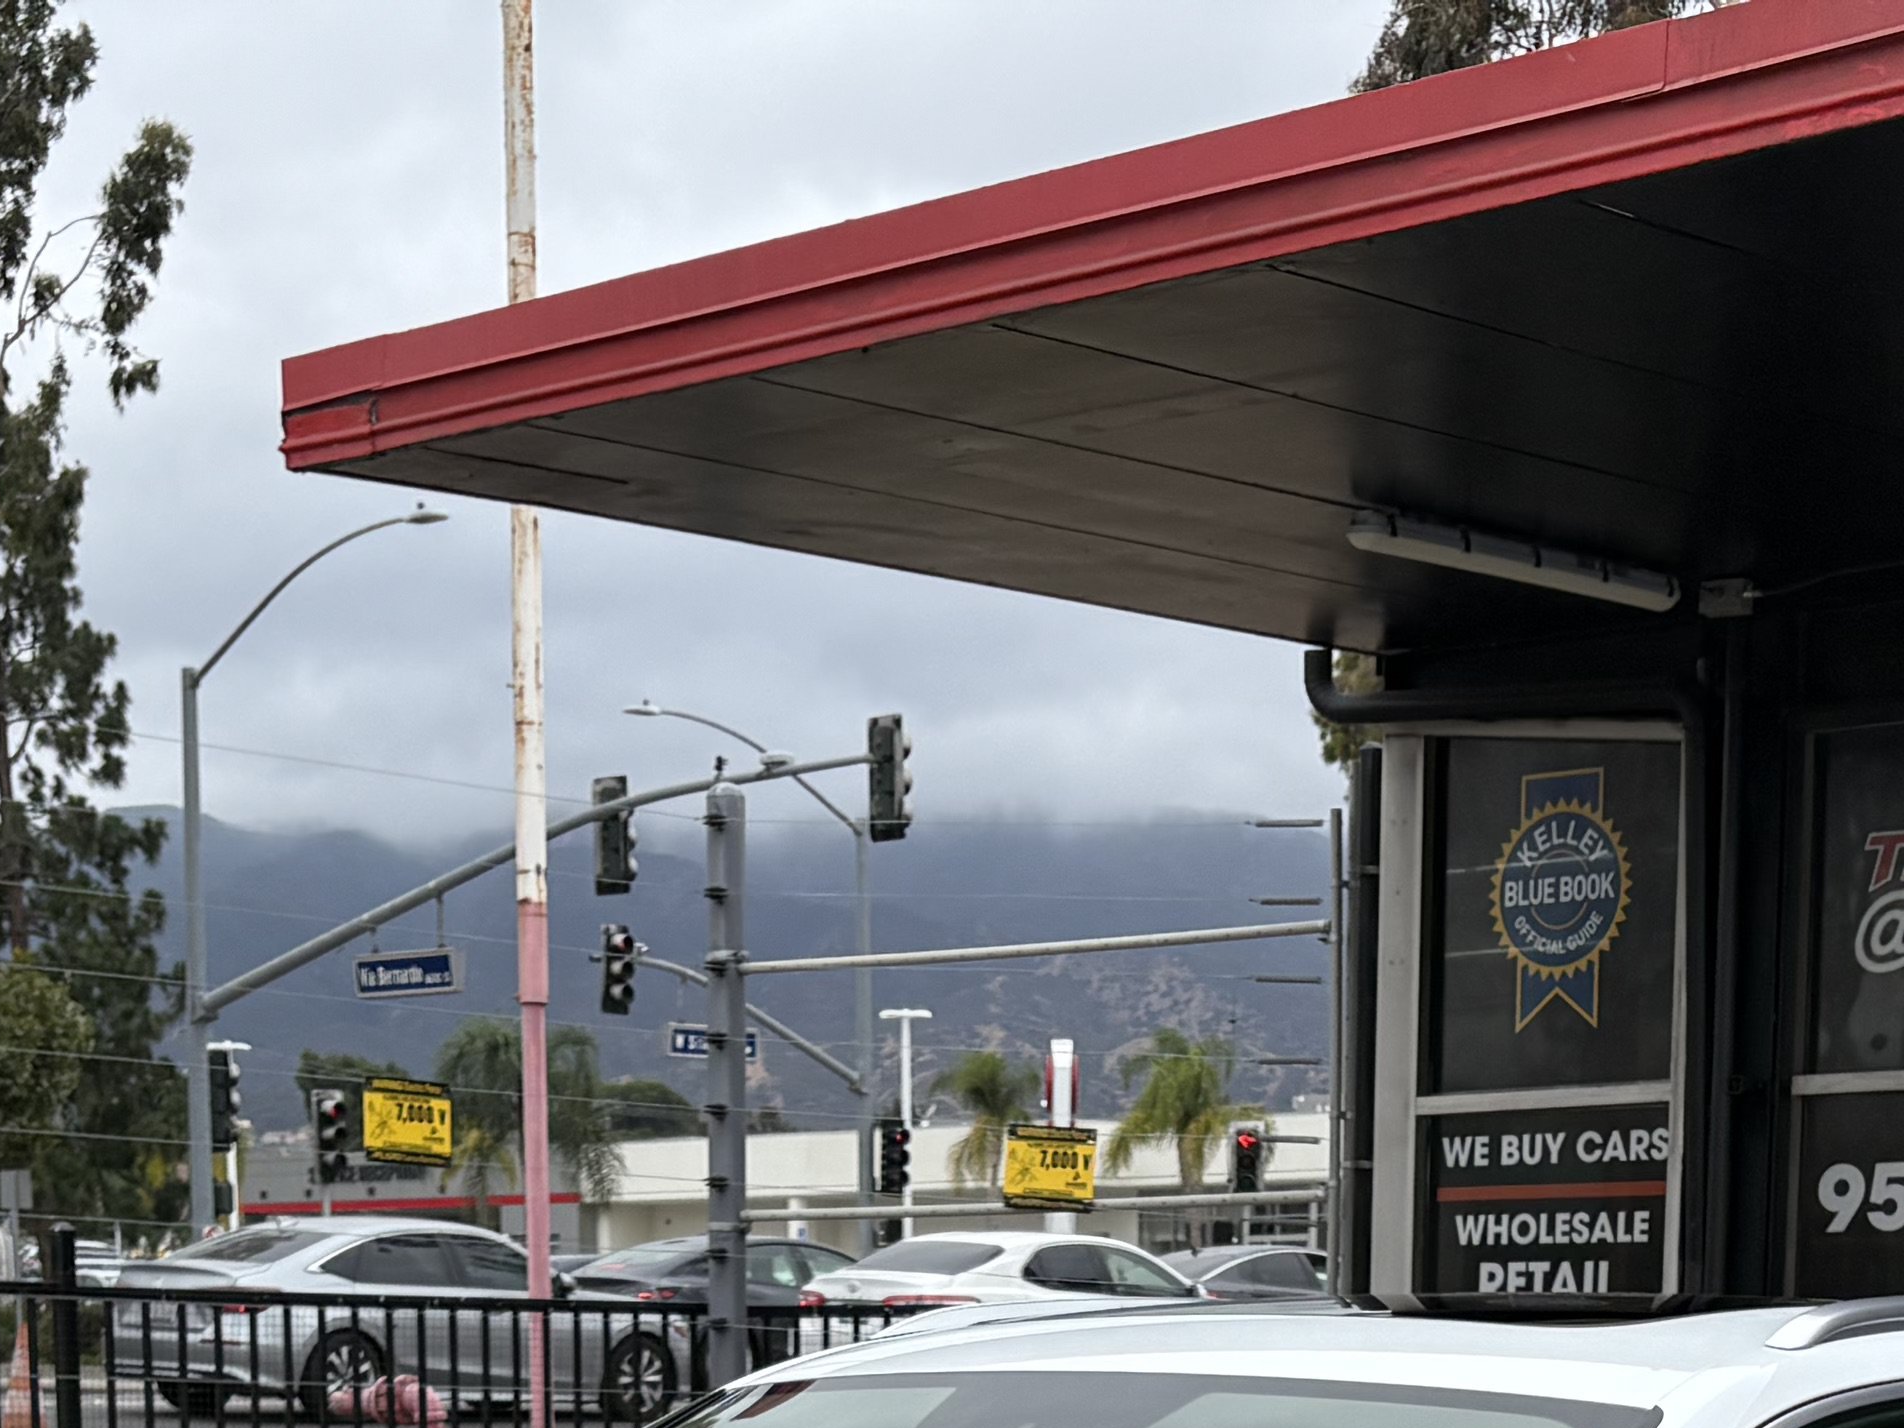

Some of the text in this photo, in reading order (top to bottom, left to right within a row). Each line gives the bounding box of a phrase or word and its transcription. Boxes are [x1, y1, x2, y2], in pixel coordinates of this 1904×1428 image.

[1517, 819, 1609, 868] KELLEY
[1504, 871, 1615, 908] BLUE BOOK
[1514, 909, 1604, 955] OFFICIAL GUIDE
[1442, 1127, 1671, 1168] WE BUY CARS
[1455, 1210, 1651, 1246] WHOLESALE
